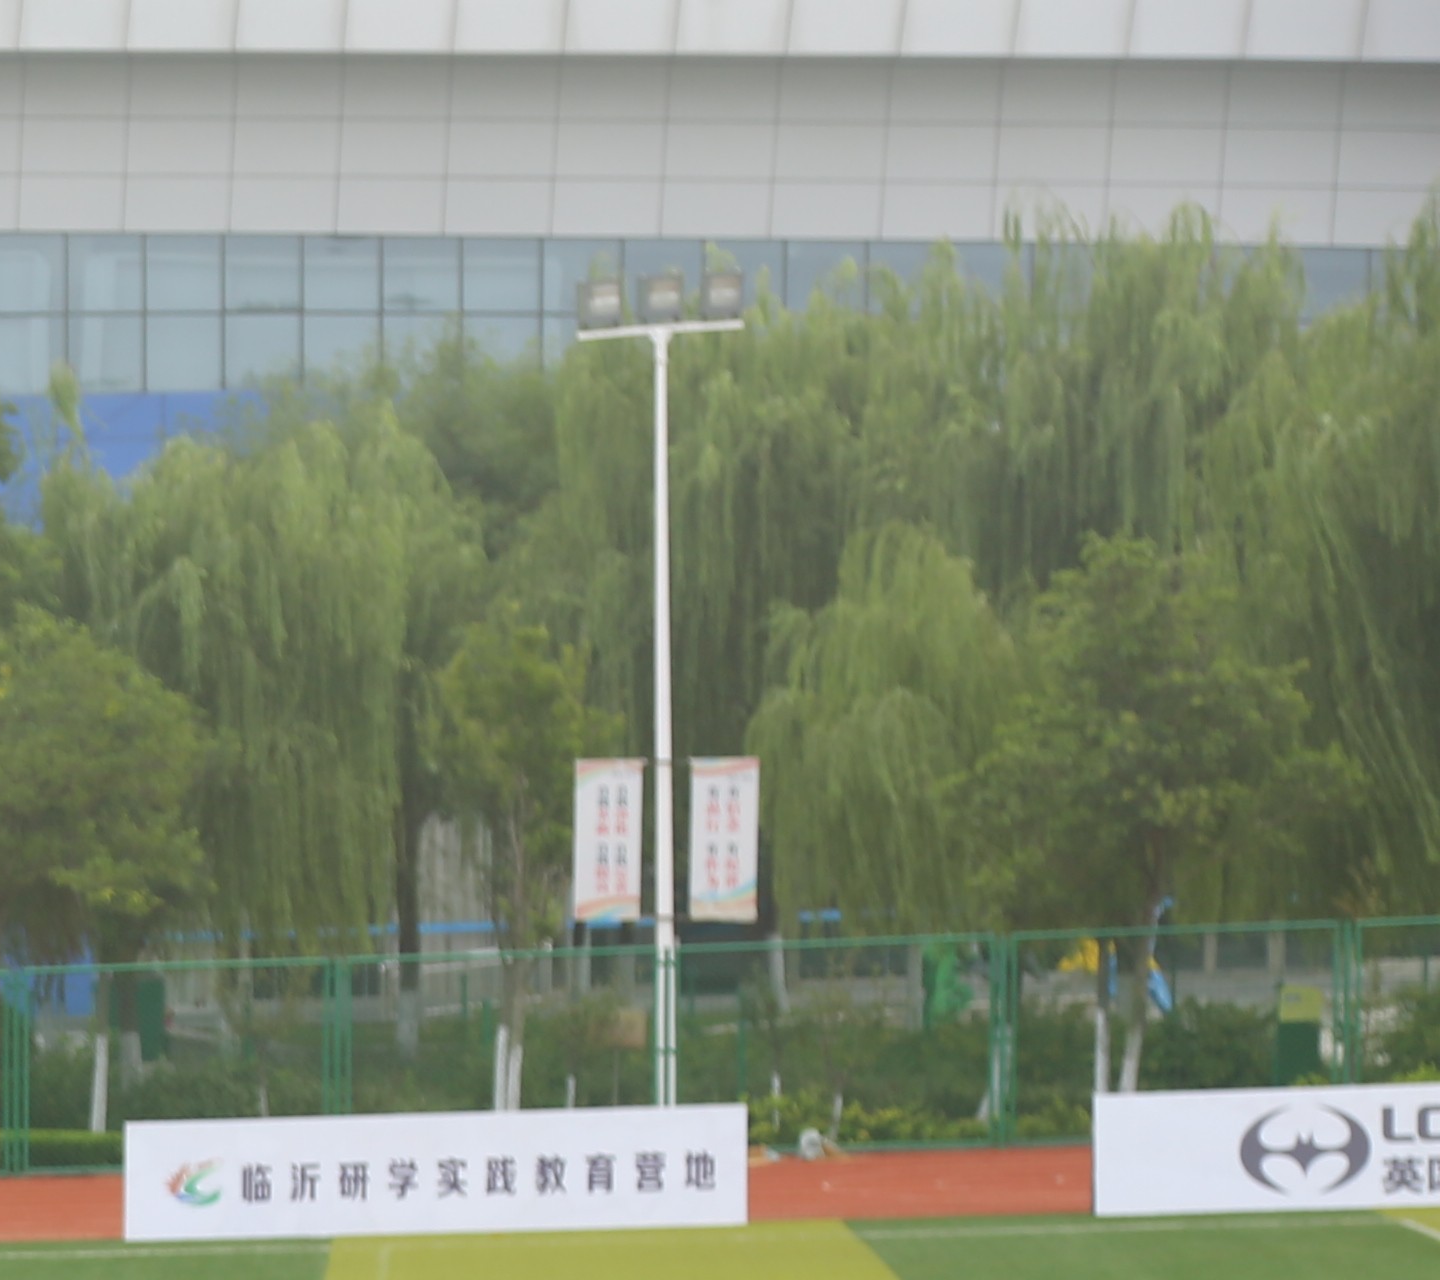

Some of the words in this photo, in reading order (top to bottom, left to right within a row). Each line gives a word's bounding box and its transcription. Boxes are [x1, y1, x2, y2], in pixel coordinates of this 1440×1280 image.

[241, 1150, 717, 1204] 临沂研学实践教育营地
